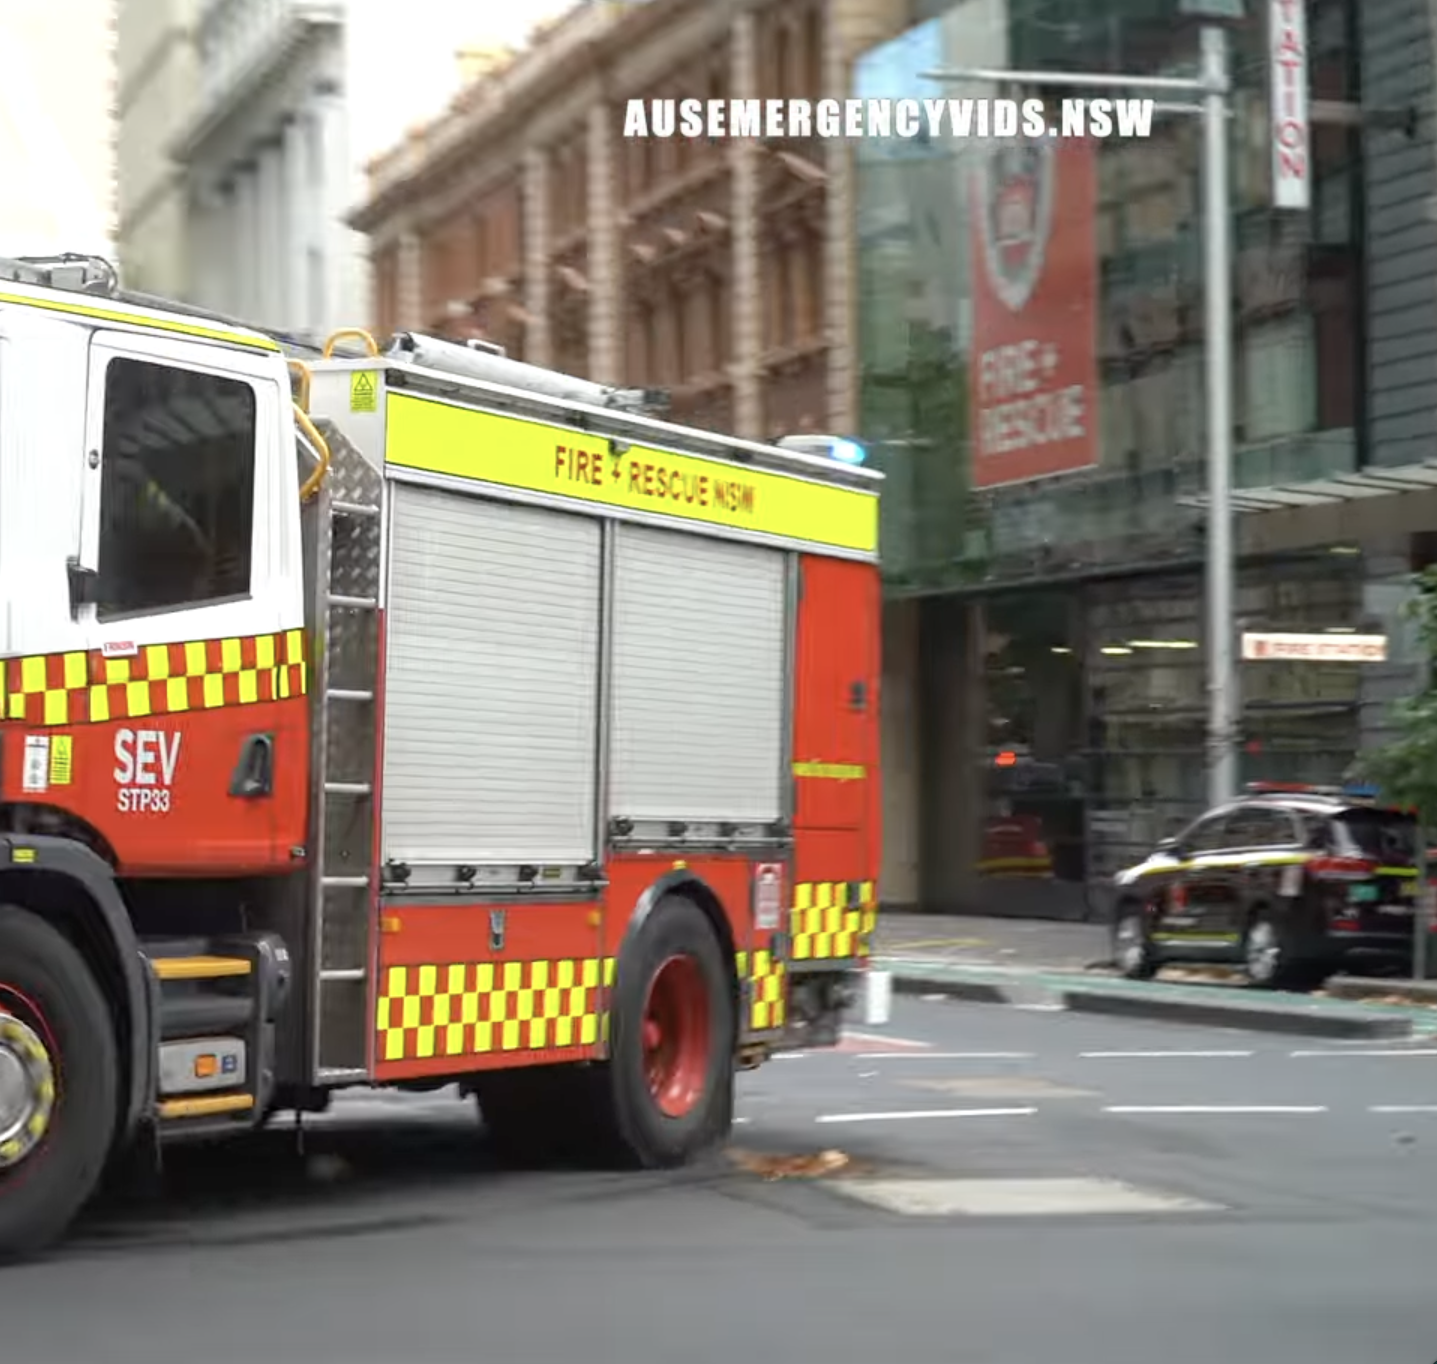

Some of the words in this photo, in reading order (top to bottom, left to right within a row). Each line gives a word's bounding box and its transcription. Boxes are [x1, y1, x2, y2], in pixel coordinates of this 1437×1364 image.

[980, 384, 1086, 455] RESCUE
[555, 445, 603, 486] FIRE
[629, 460, 708, 506] RESCUE
[113, 728, 182, 786] SEV
[117, 787, 171, 812] STP33
